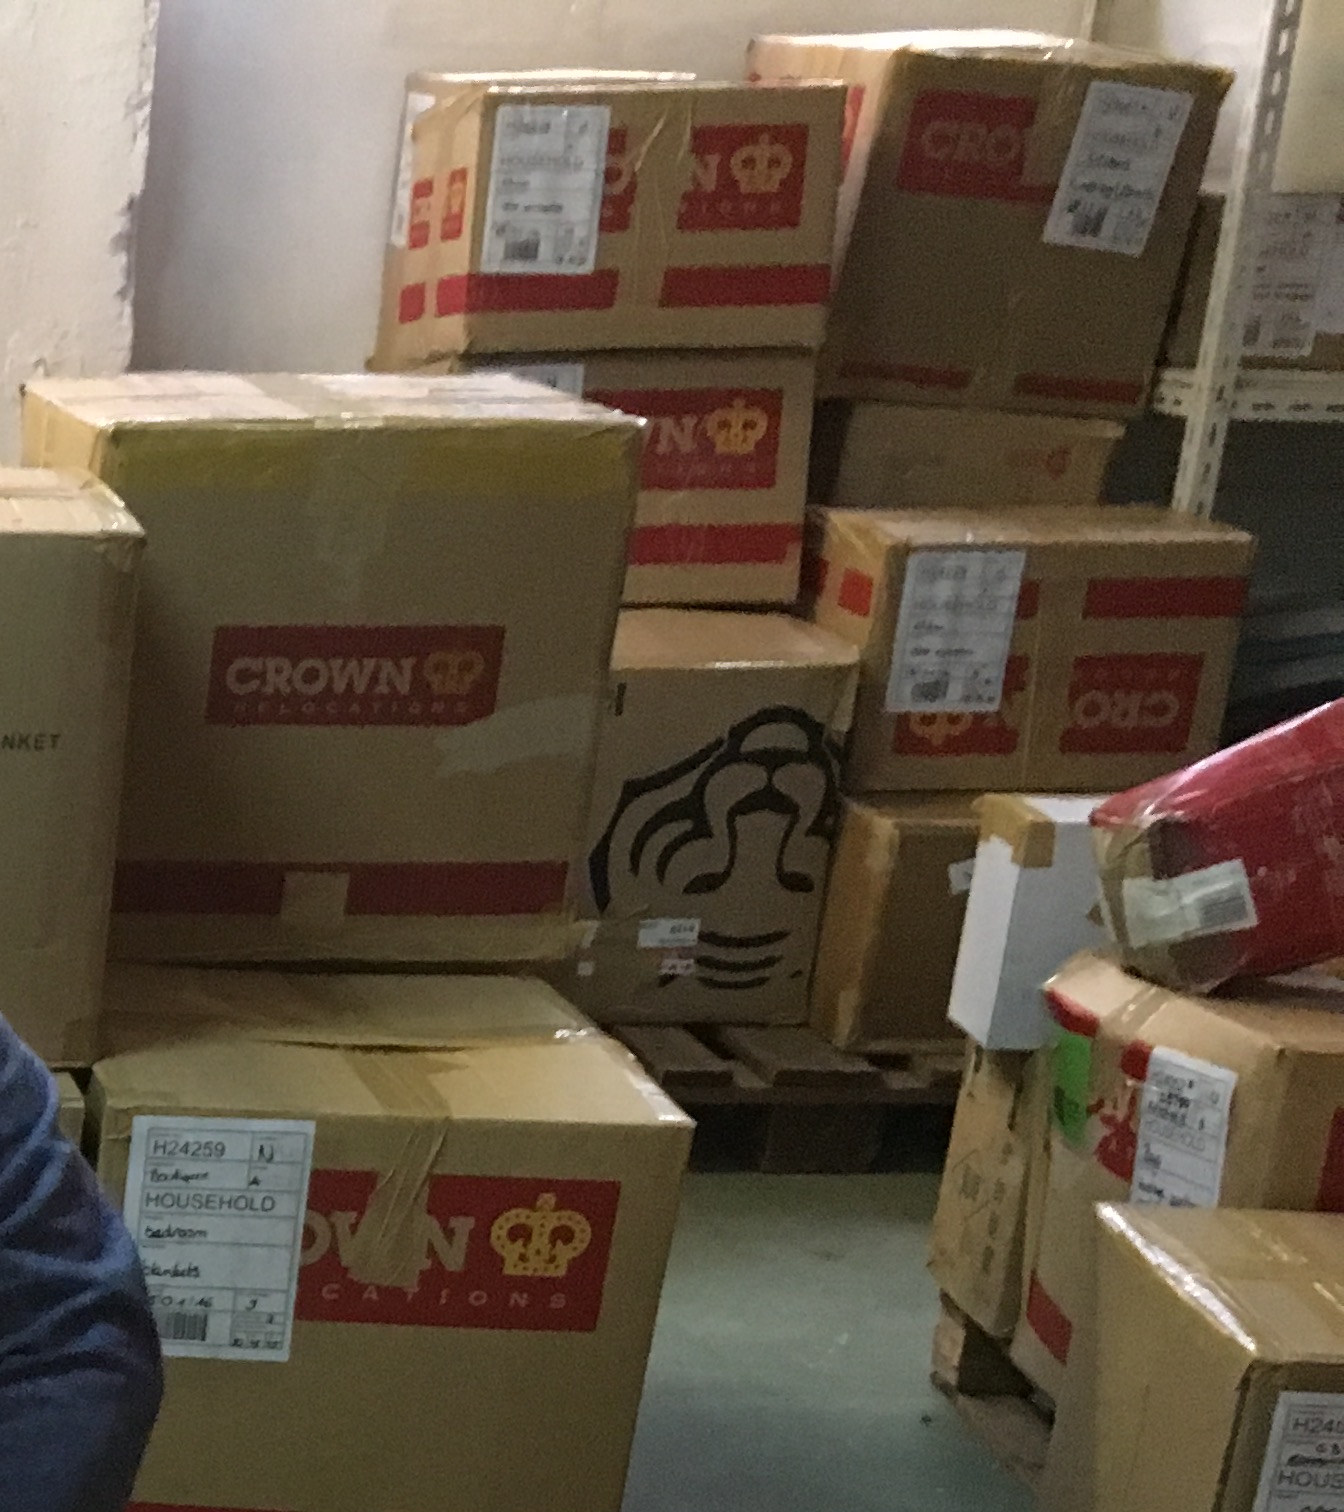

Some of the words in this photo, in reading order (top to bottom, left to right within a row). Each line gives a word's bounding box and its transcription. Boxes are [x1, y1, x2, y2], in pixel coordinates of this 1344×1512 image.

[225, 655, 417, 696] CROWN
[153, 1140, 226, 1158] H24259
[144, 1192, 276, 1212] HOUSEHOLD
